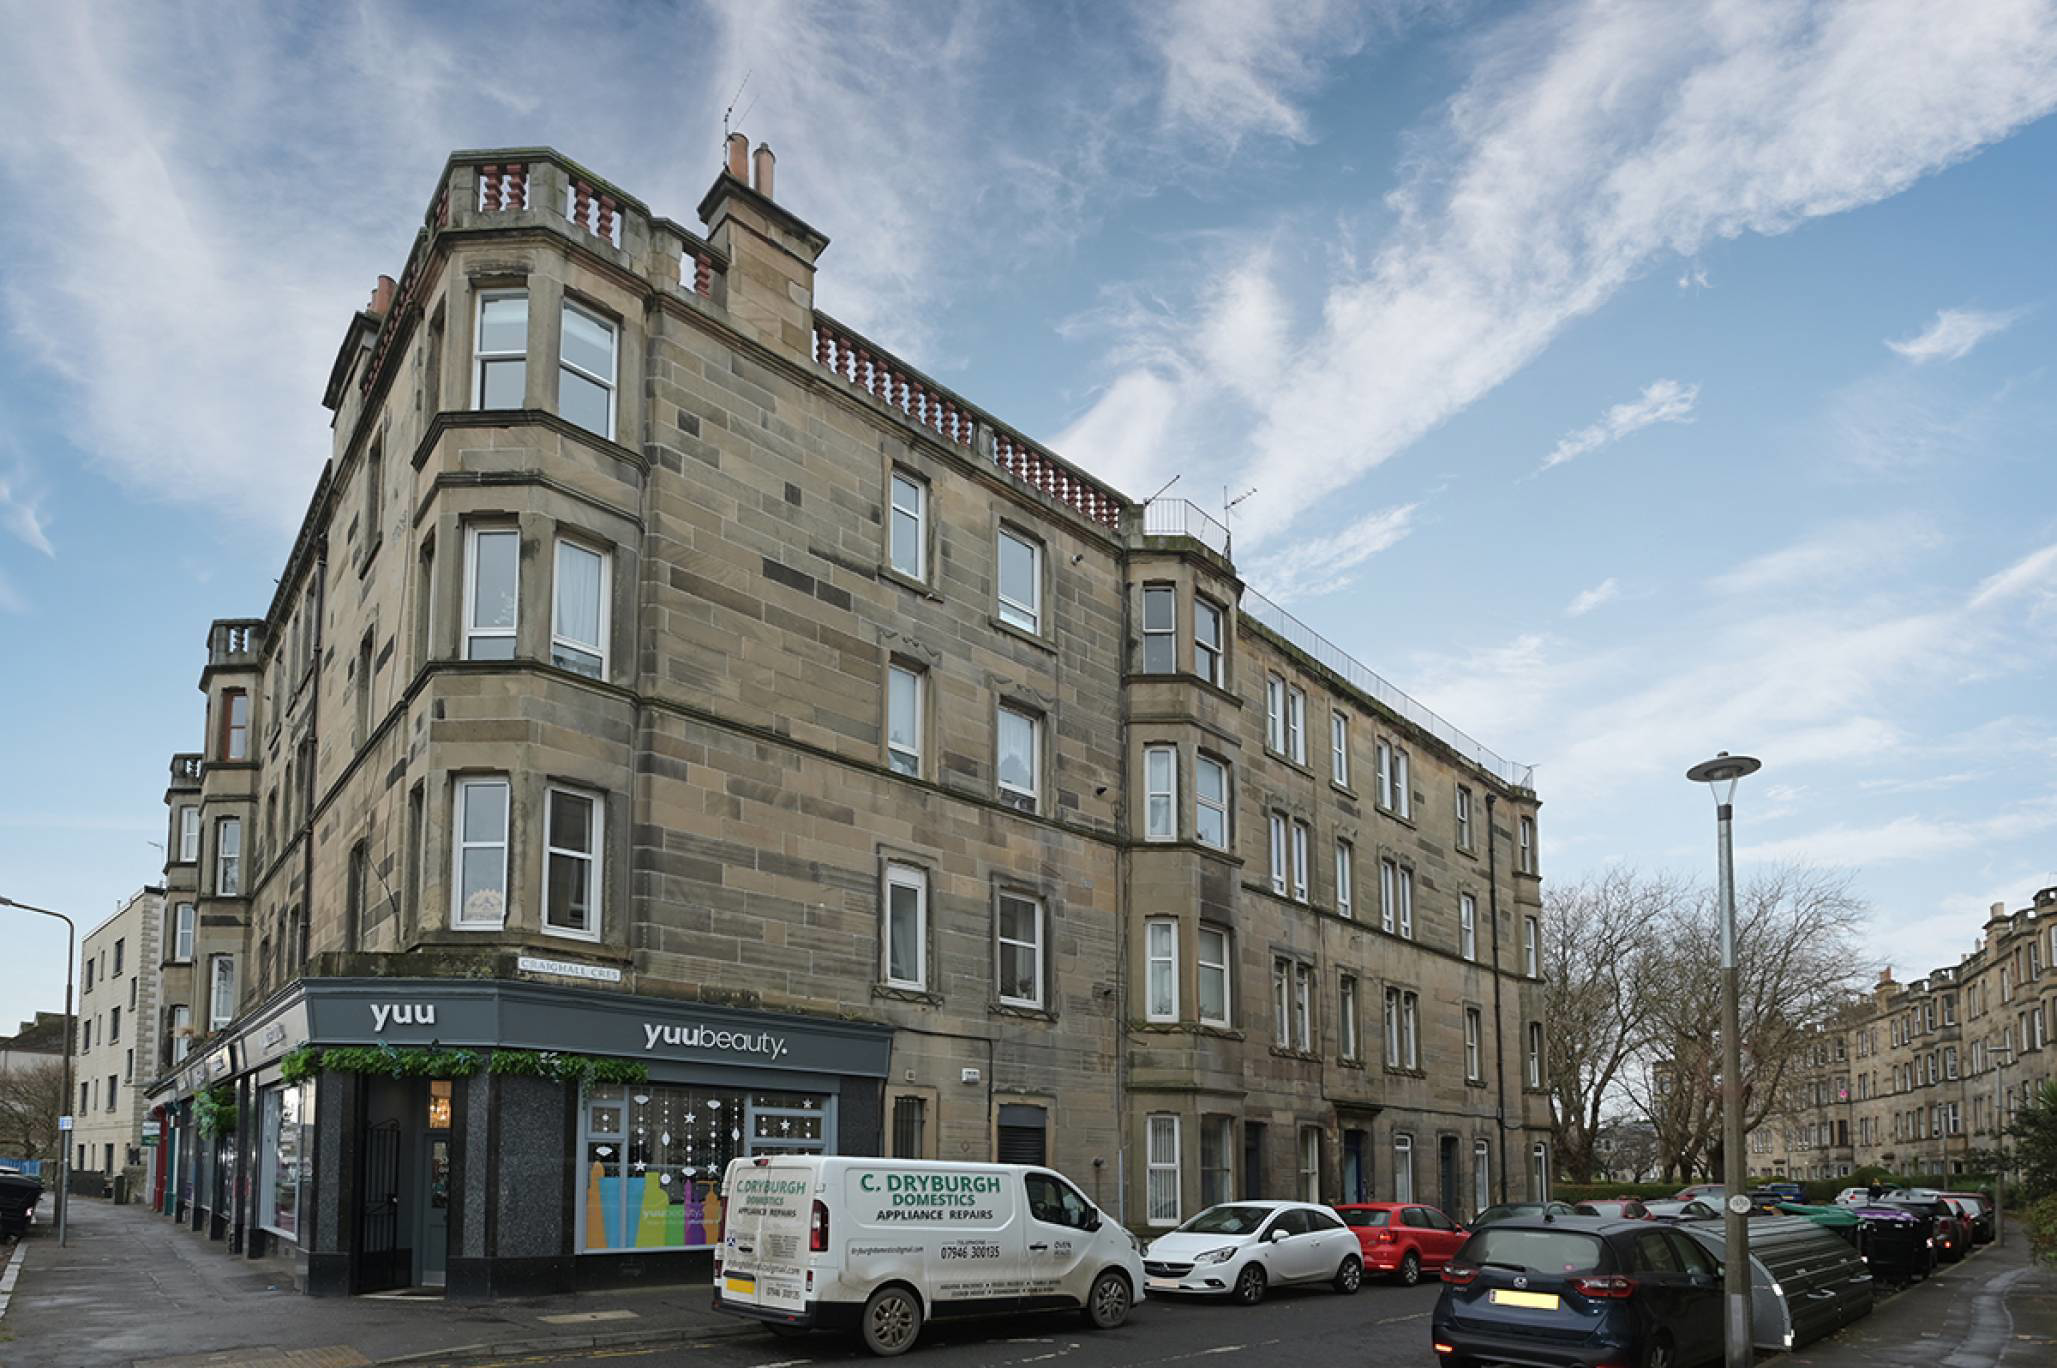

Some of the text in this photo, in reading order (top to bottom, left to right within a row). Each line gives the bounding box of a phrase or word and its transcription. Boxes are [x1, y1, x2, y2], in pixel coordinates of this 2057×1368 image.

[521, 959, 585, 976] CRAIGHALL
[370, 1004, 435, 1032] yuu
[643, 1023, 788, 1060] yuubeauty.
[861, 1174, 1001, 1193] C. DRYBURGH
[892, 1194, 976, 1206] DOMESTICS
[876, 1209, 993, 1220] APPLIANCE REPAIRS
[940, 1246, 1000, 1260] 07946 300135
